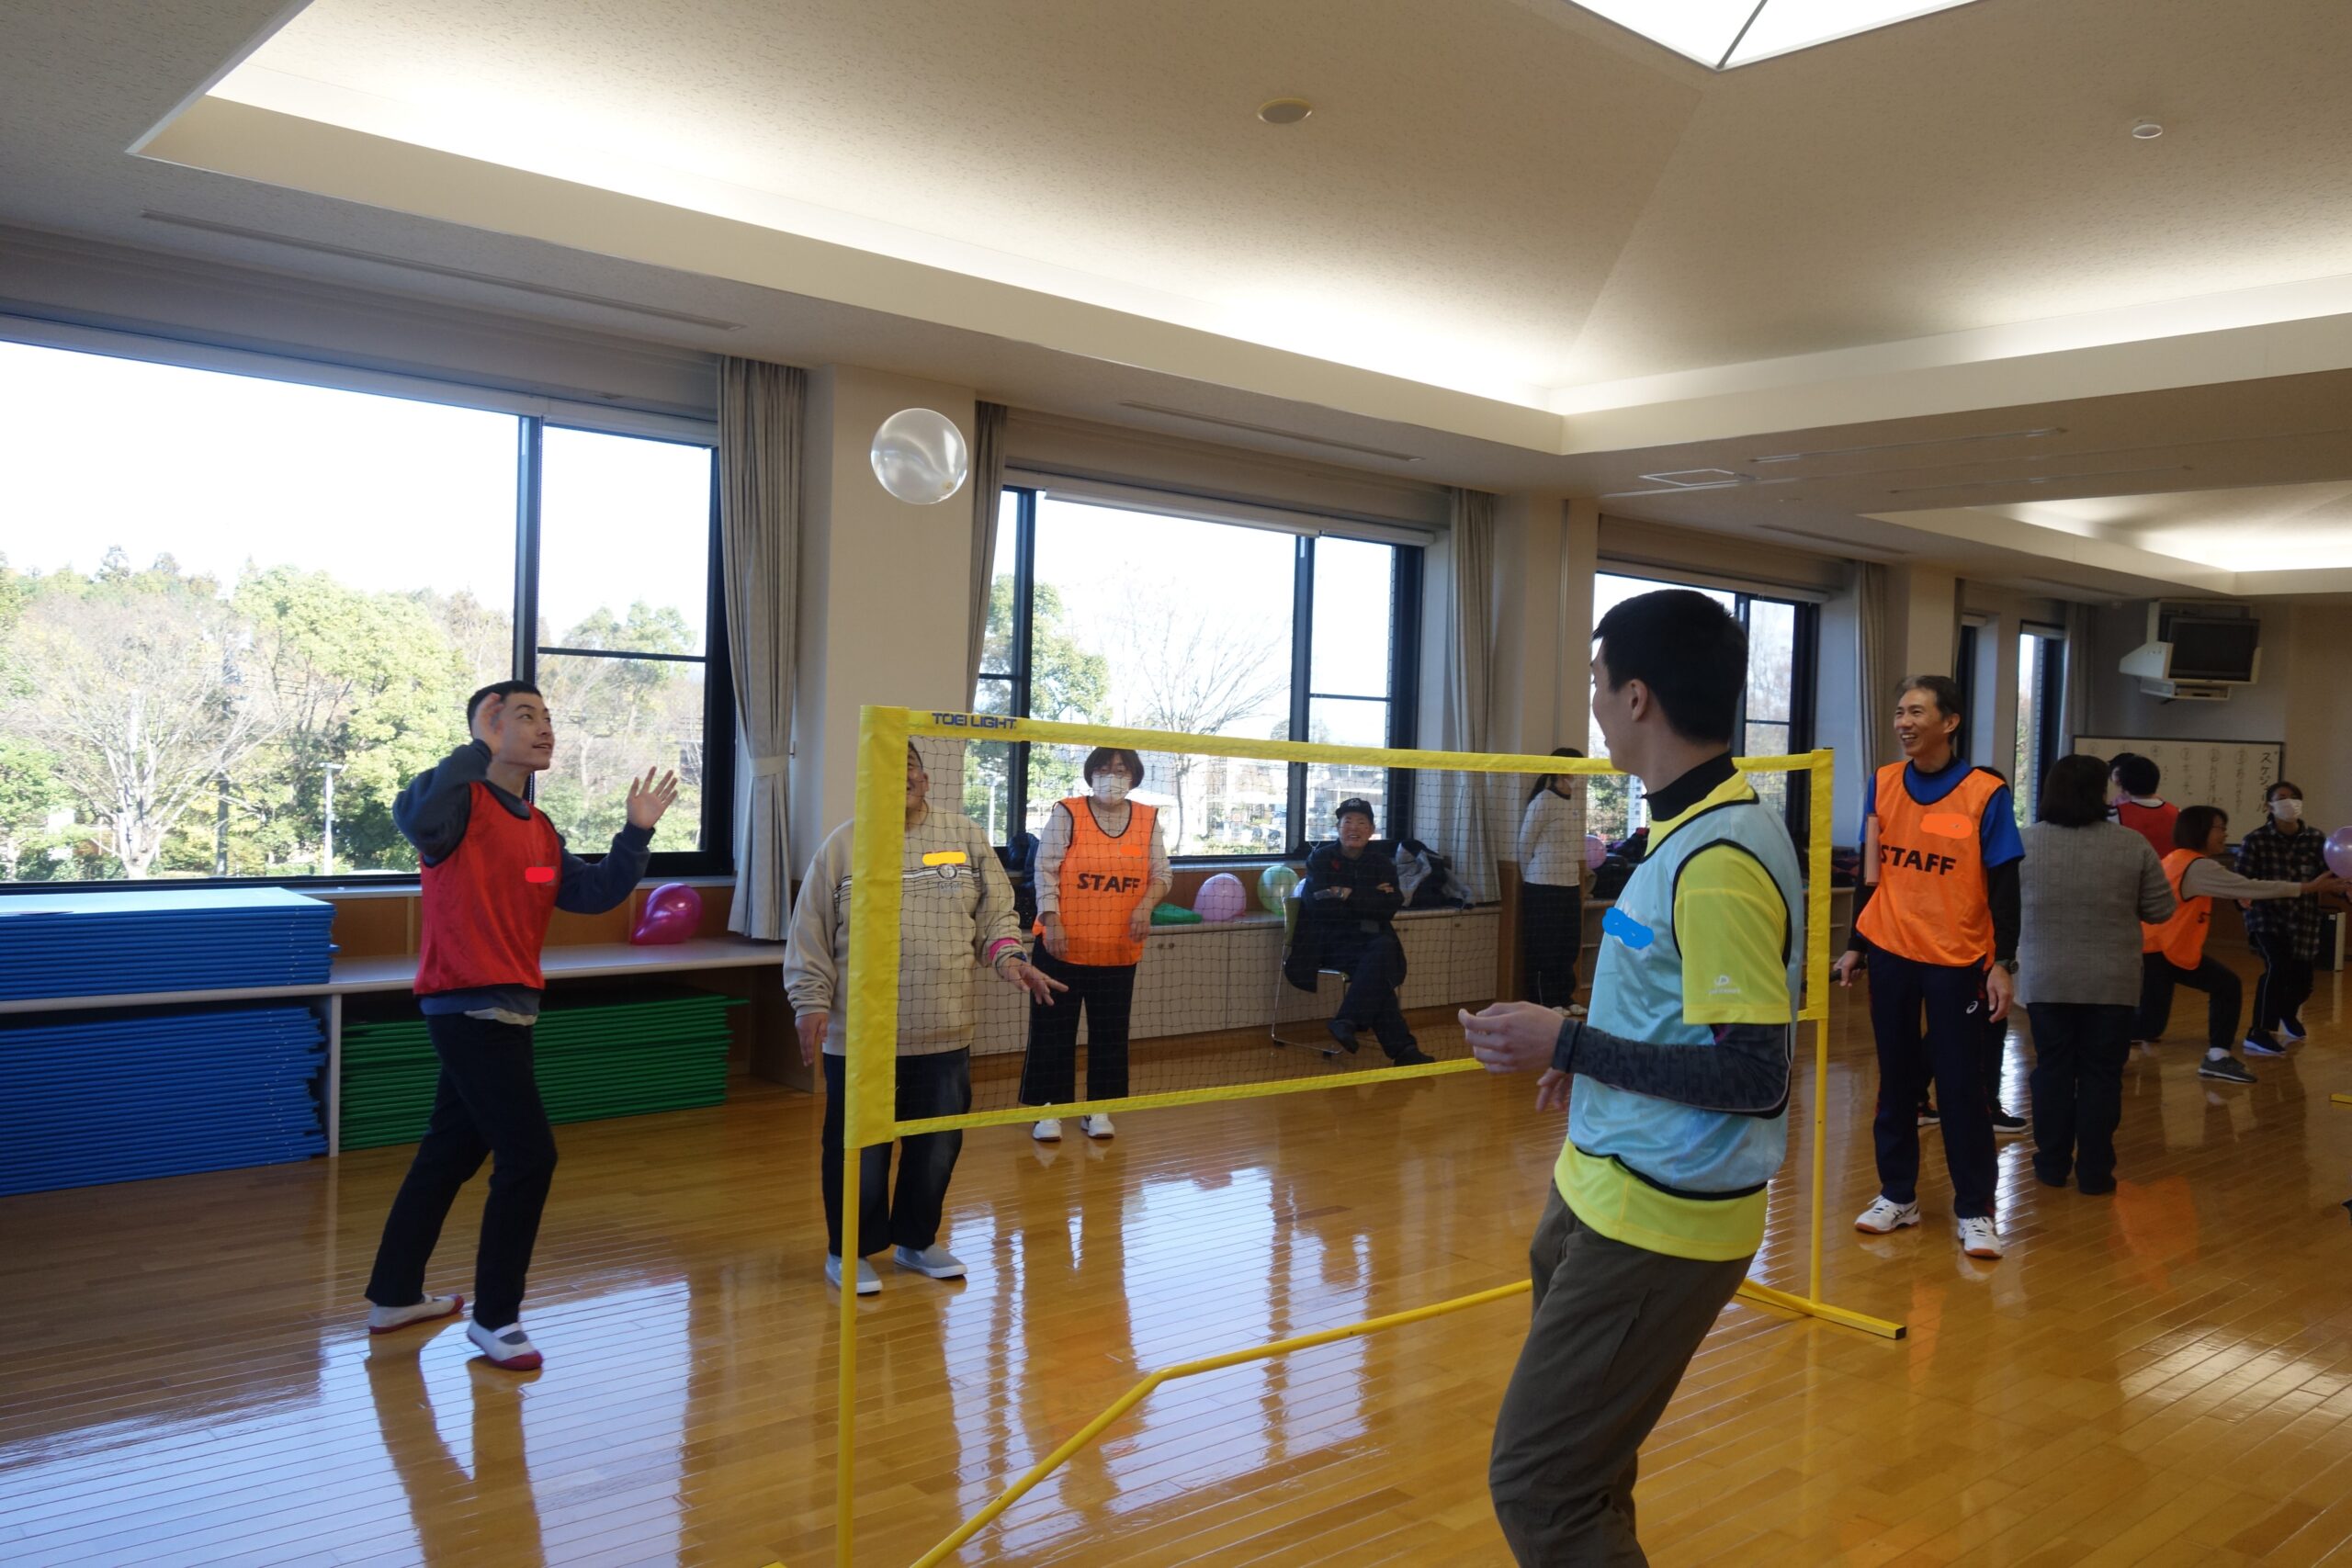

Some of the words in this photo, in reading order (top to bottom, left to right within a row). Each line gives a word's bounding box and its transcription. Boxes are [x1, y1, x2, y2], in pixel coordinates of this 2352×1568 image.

[932, 712, 967, 727] TOEI
[970, 715, 1017, 729] LIGHT
[1077, 873, 1141, 894] STAFF
